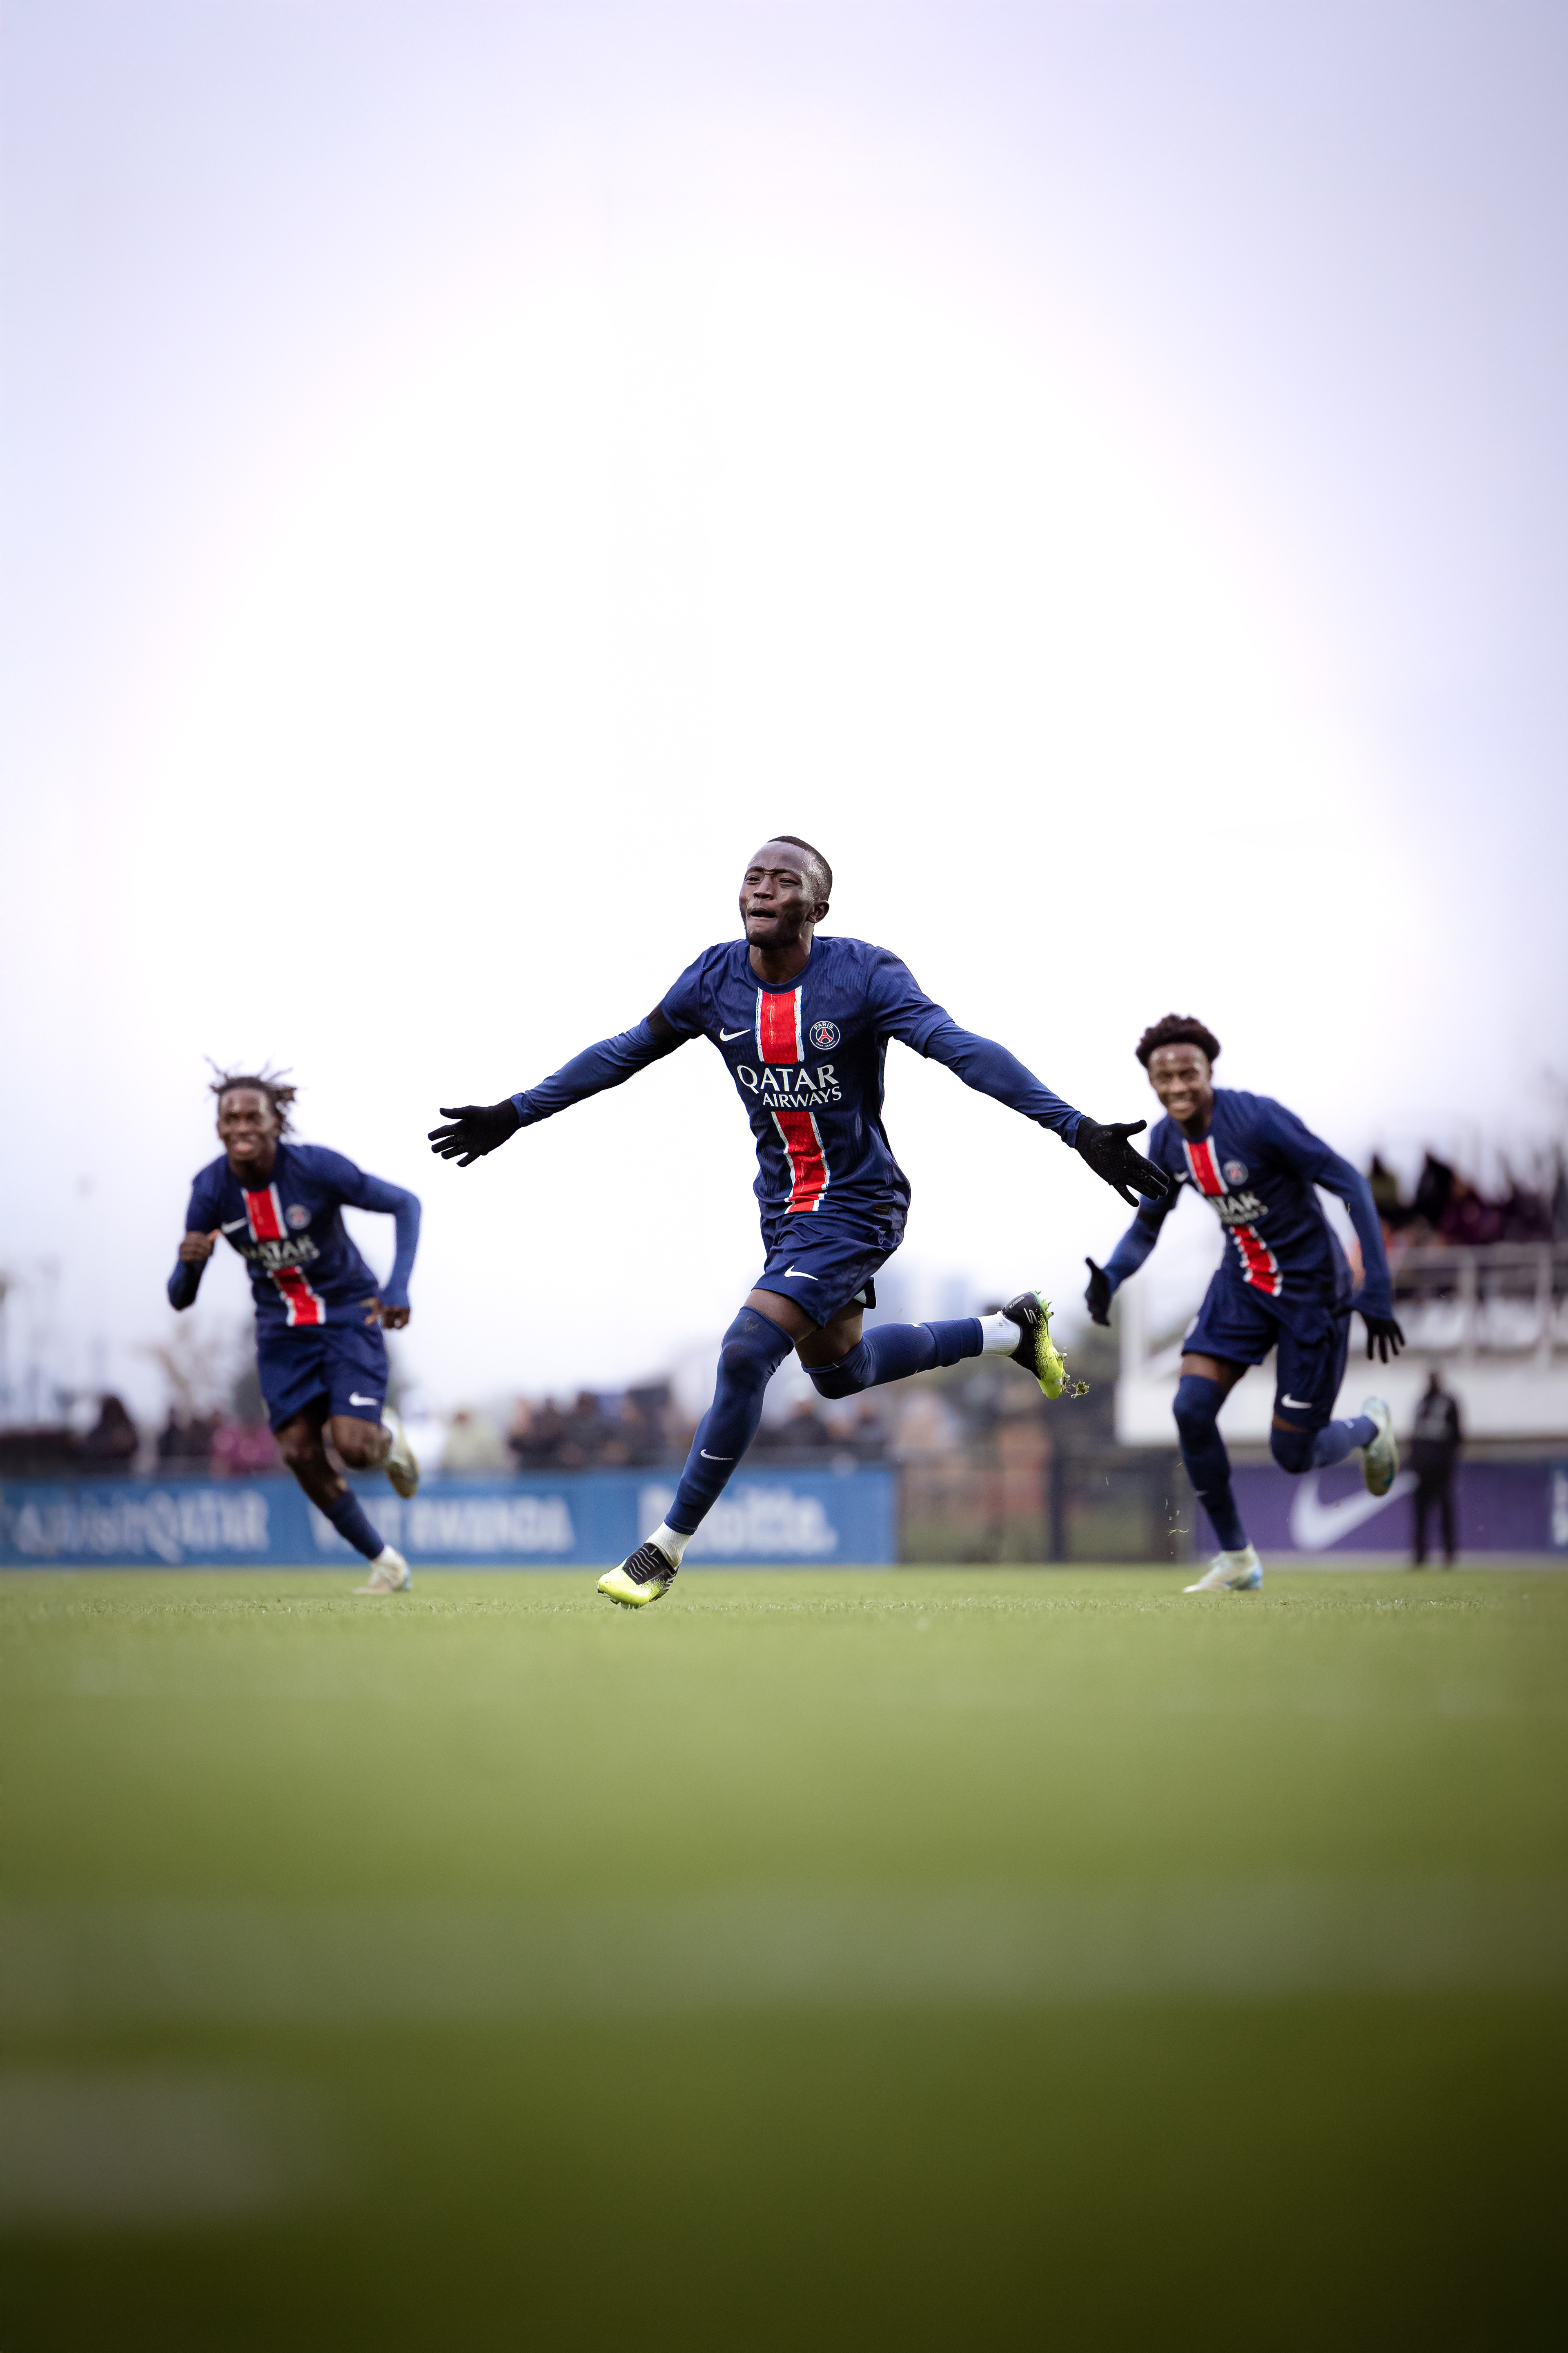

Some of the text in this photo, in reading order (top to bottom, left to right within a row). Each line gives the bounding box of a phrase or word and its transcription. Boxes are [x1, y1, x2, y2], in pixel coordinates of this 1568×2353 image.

[814, 1022, 834, 1030] PARIS
[737, 1065, 839, 1094] QATAR
[763, 1086, 842, 1107] AIRWAYS
